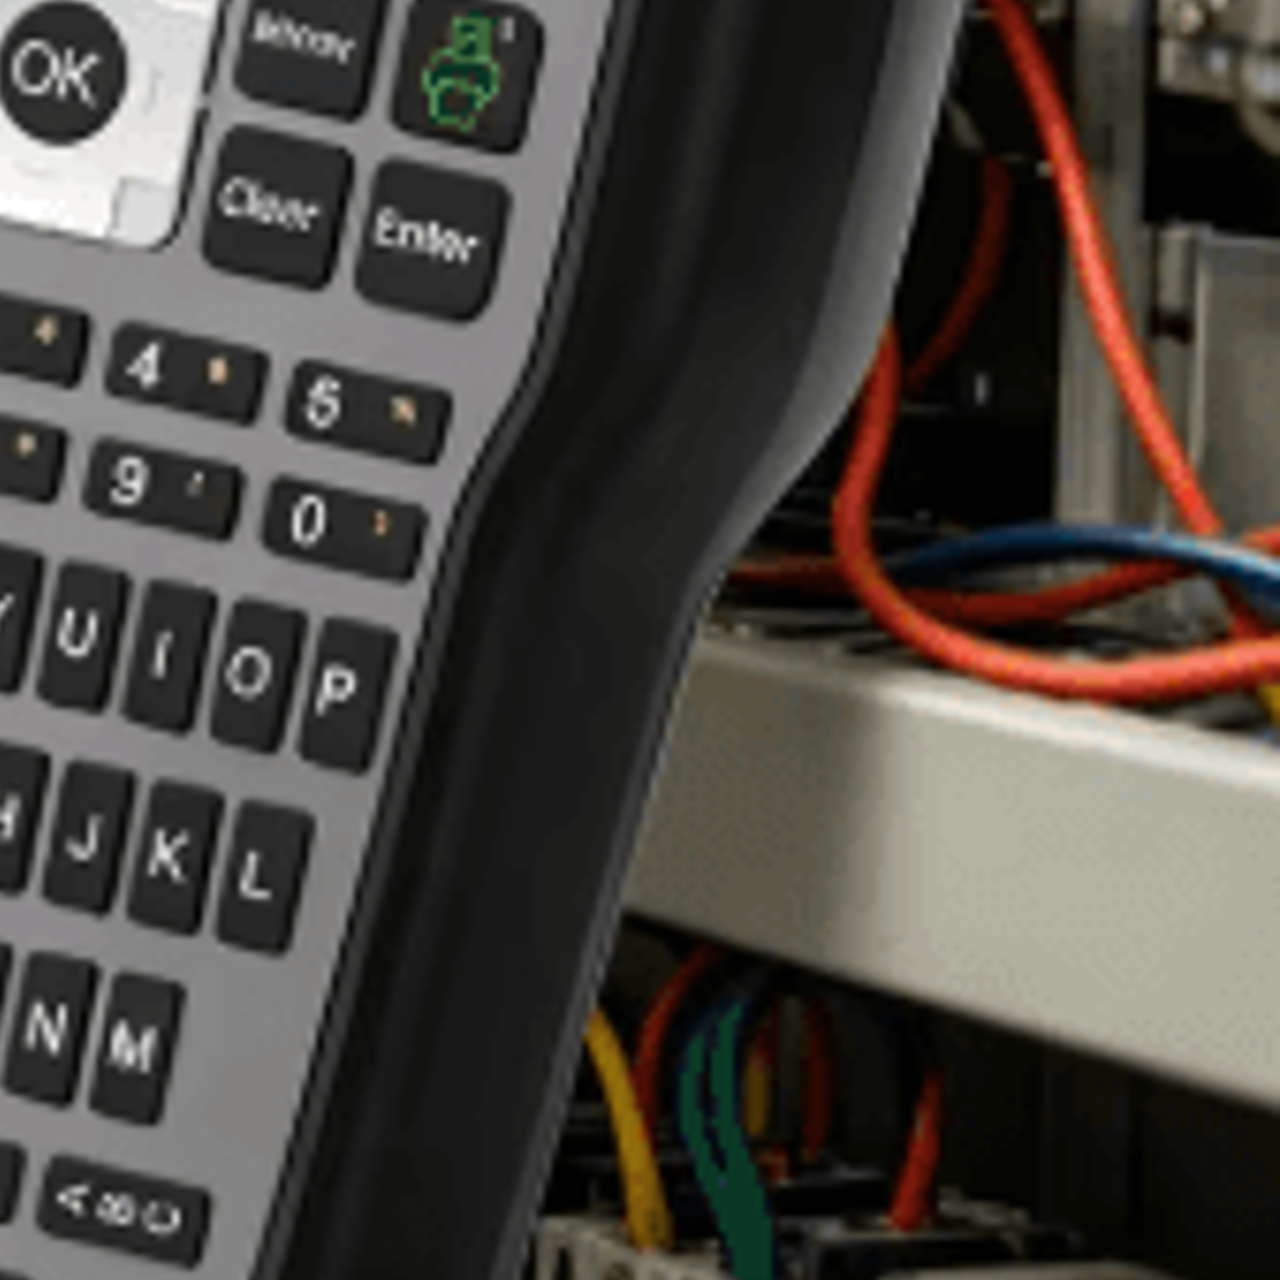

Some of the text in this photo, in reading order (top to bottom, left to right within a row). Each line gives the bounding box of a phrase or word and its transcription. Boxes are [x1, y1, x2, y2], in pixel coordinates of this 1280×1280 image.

[10, 38, 100, 104] OK
[374, 206, 480, 264] Enter
[125, 340, 162, 389] 4
[109, 454, 150, 507] 9
[289, 492, 328, 546] 0
[55, 606, 100, 660] U
[151, 630, 174, 679] I
[223, 644, 274, 700] O
[314, 664, 358, 715] P
[64, 814, 101, 863] J
[146, 827, 189, 882] K
[237, 849, 273, 902] L
[24, 1000, 69, 1056] N
[108, 1019, 158, 1074] M
